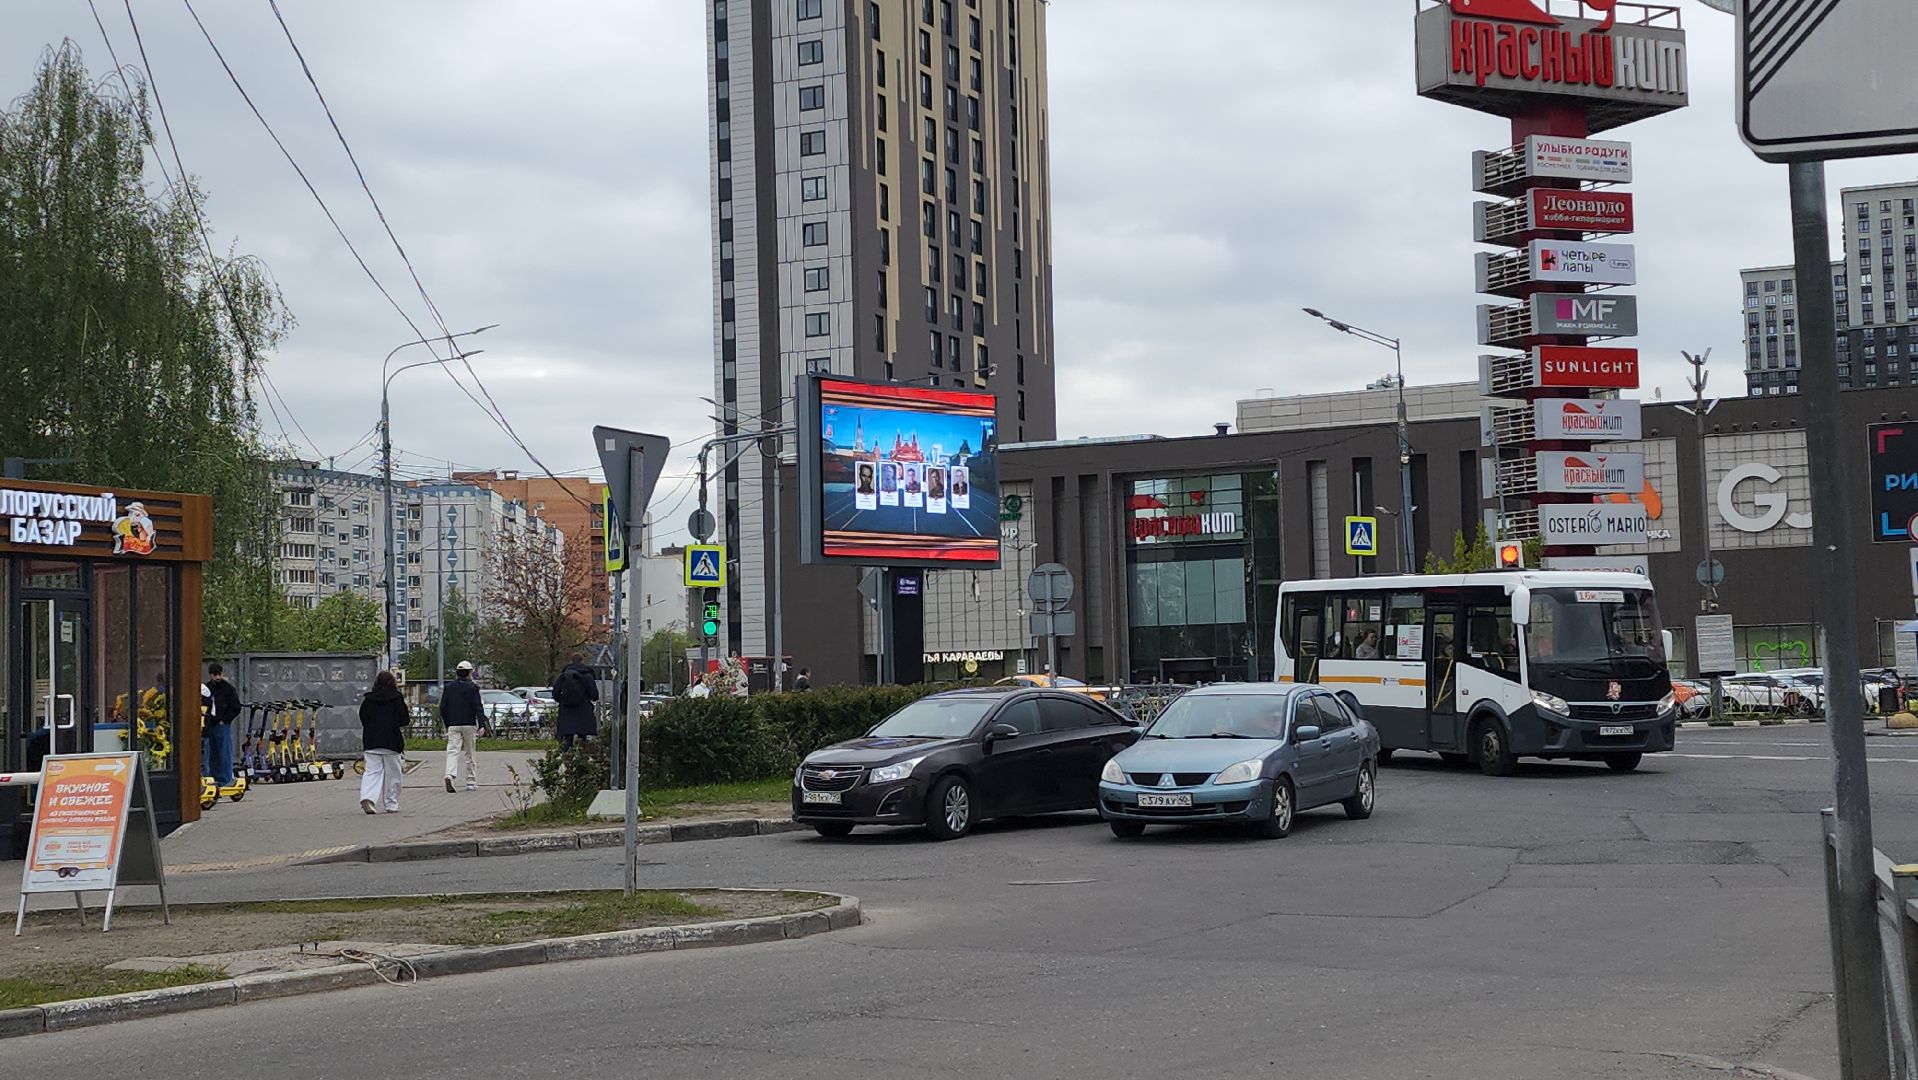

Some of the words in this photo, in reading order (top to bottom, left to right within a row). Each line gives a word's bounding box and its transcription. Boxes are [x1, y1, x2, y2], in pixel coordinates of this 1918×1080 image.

[1543, 195, 1625, 216] Леонардо
[1571, 298, 1617, 321] MF
[1544, 360, 1634, 374] SUNLIGHT
[10, 518, 82, 545] БАЗАР
[1607, 515, 1646, 533] MARIO
[942, 651, 1004, 663] КАРАВАЕВЫ
[55, 783, 110, 793] ВКУСНОЕ
[48, 796, 58, 806] И
[60, 795, 114, 806] СВЕЖЕЕ
